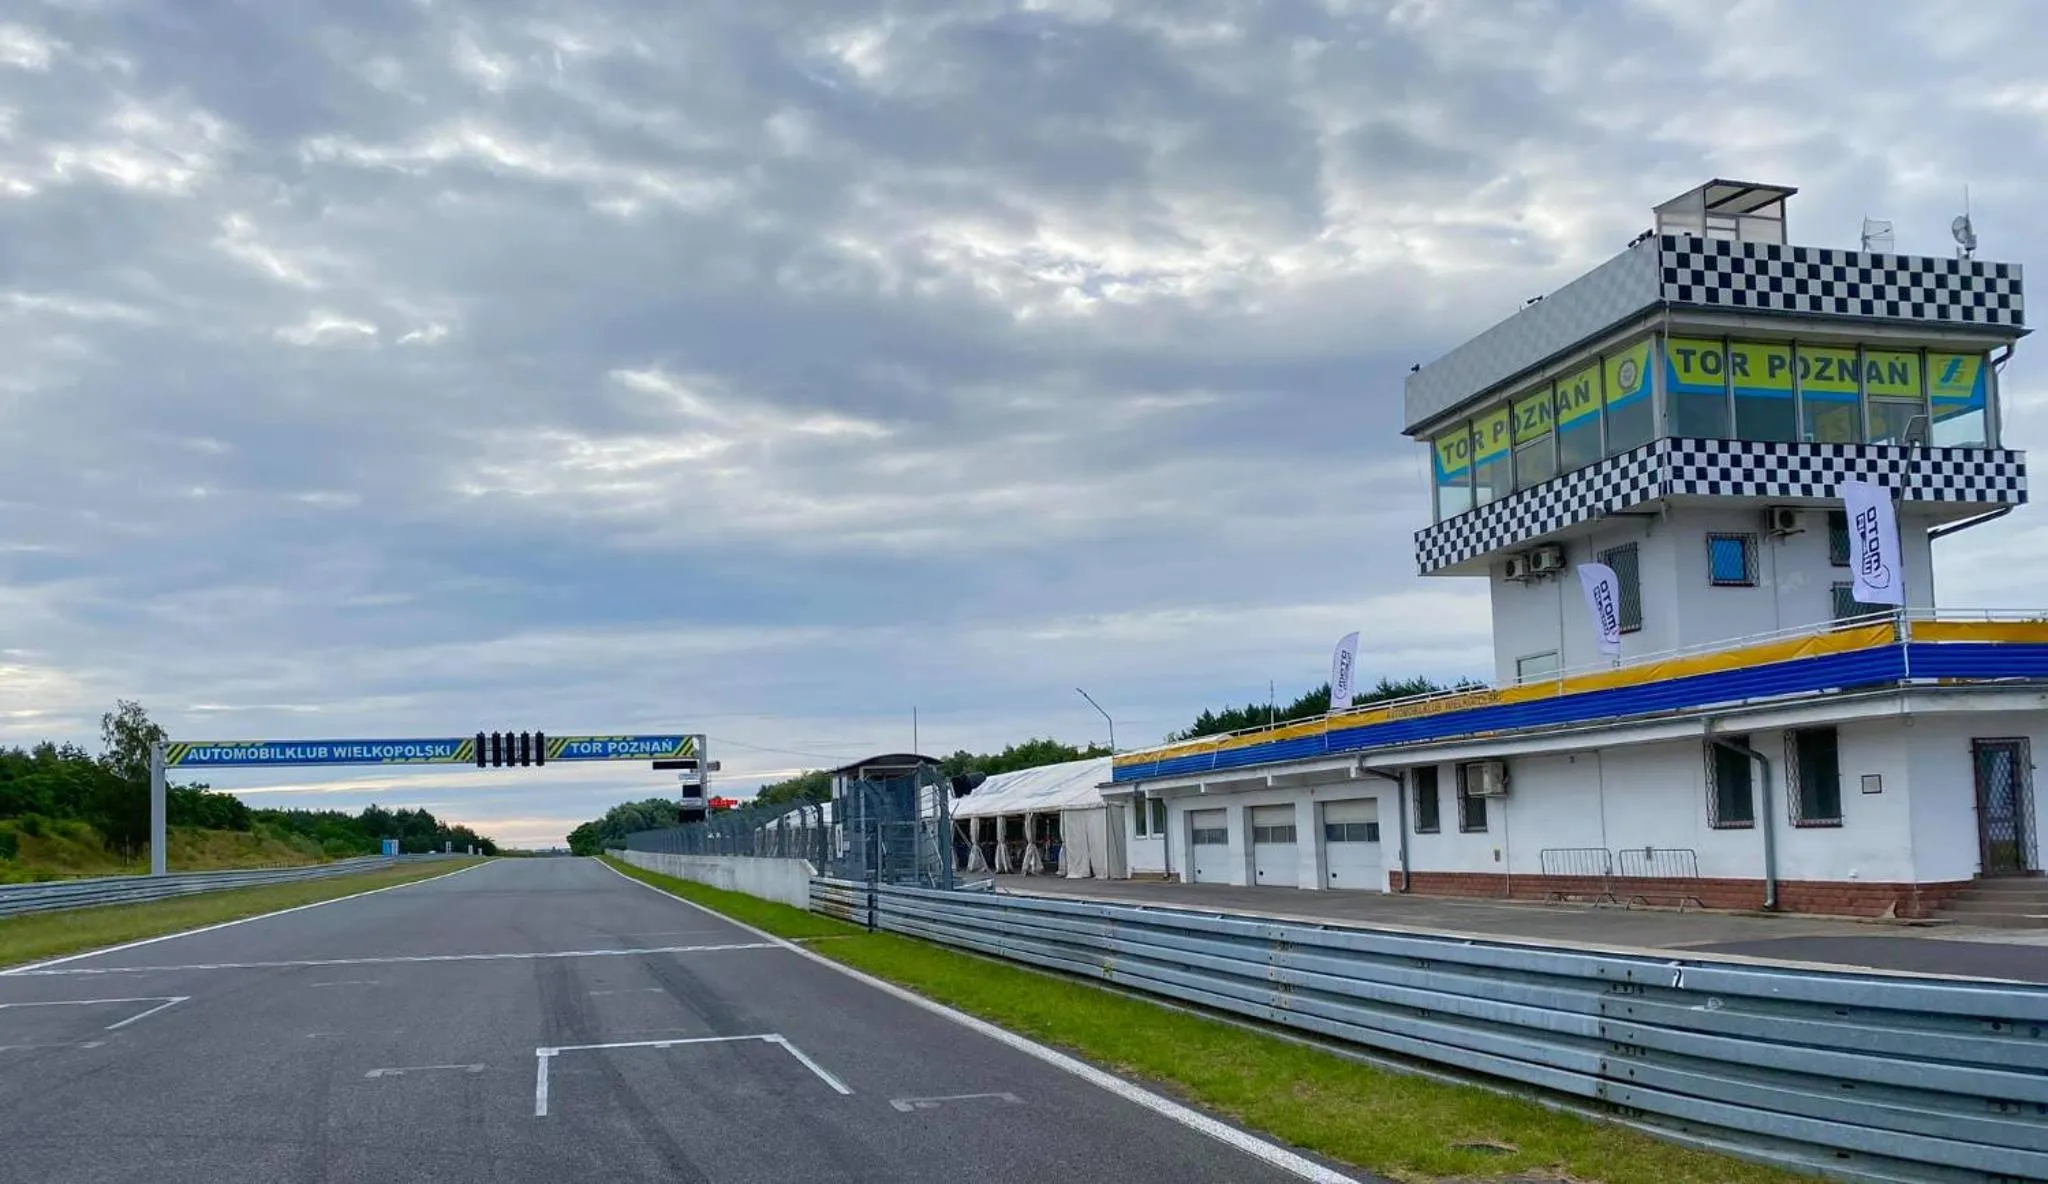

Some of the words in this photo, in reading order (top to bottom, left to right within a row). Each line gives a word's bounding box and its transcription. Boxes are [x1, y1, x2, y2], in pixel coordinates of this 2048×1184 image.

[1676, 349, 1750, 377] TOR
[1768, 356, 1909, 385] POZNAŃ
[1443, 432, 1484, 464] TOR
[1492, 376, 1590, 443] POZNAŃ
[188, 747, 328, 760] AUTOMOBILKLUB
[334, 745, 451, 758] WIELKOPOLSKI
[570, 742, 602, 753] TOR
[607, 739, 673, 752] POZNAŃ
